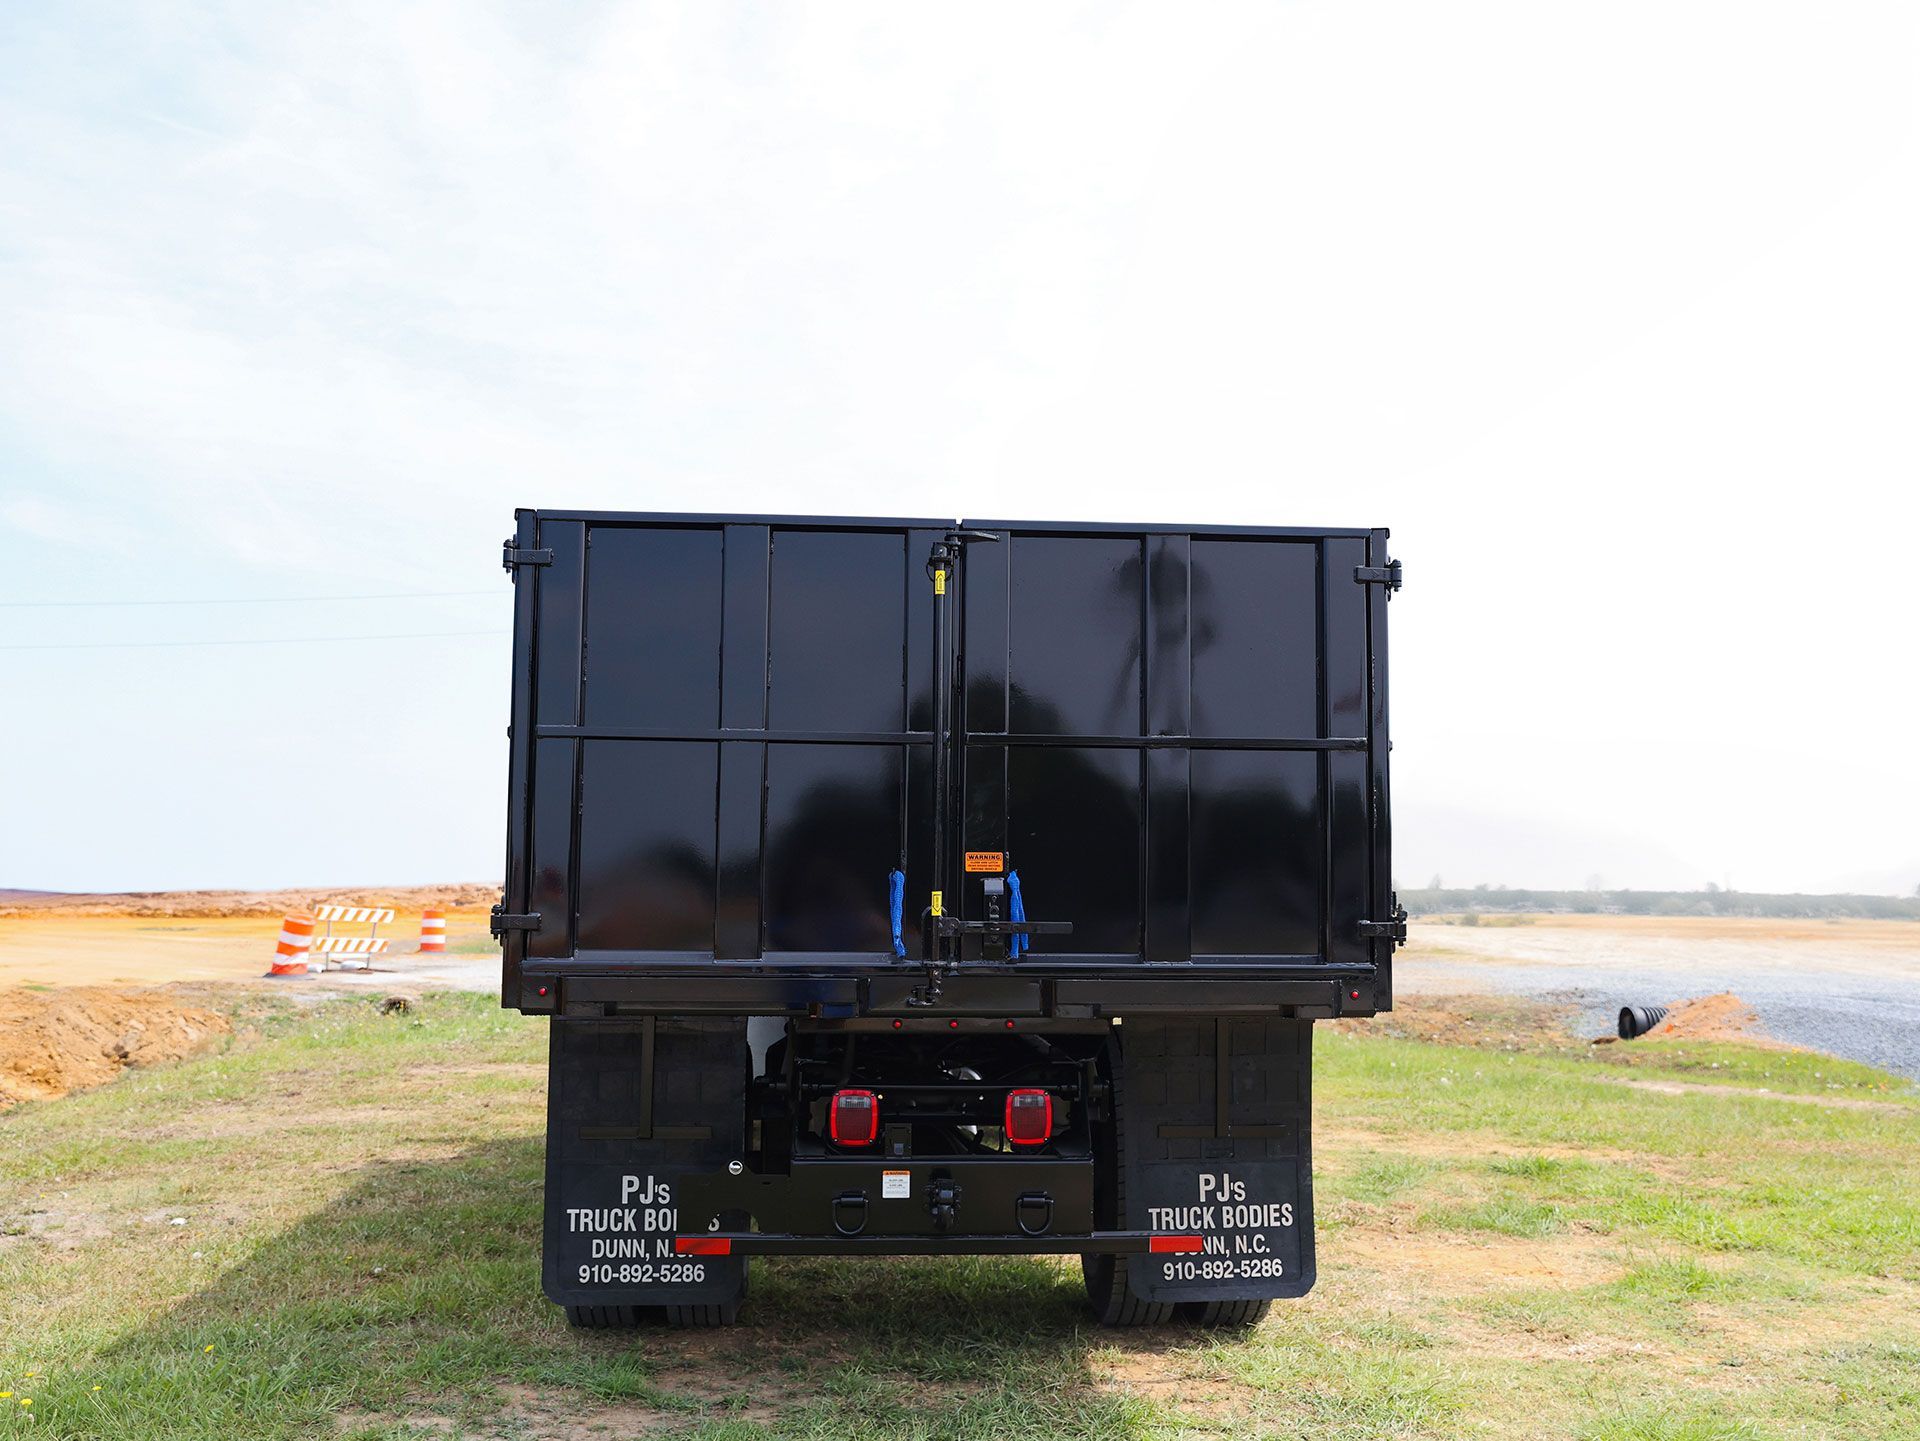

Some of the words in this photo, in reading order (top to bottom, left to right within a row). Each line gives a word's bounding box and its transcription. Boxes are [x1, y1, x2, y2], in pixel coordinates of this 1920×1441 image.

[622, 1175, 671, 1204] PJ's
[1199, 1173, 1246, 1203] PJ's
[566, 1208, 637, 1232] TRUCK
[1148, 1206, 1216, 1231] TRUCK
[1222, 1203, 1293, 1229] BODIES
[592, 1239, 650, 1261] DUNN,
[1235, 1233, 1271, 1255] N.C.
[578, 1264, 705, 1283] 910-892-5286
[1163, 1258, 1283, 1281] 910-892-5286
